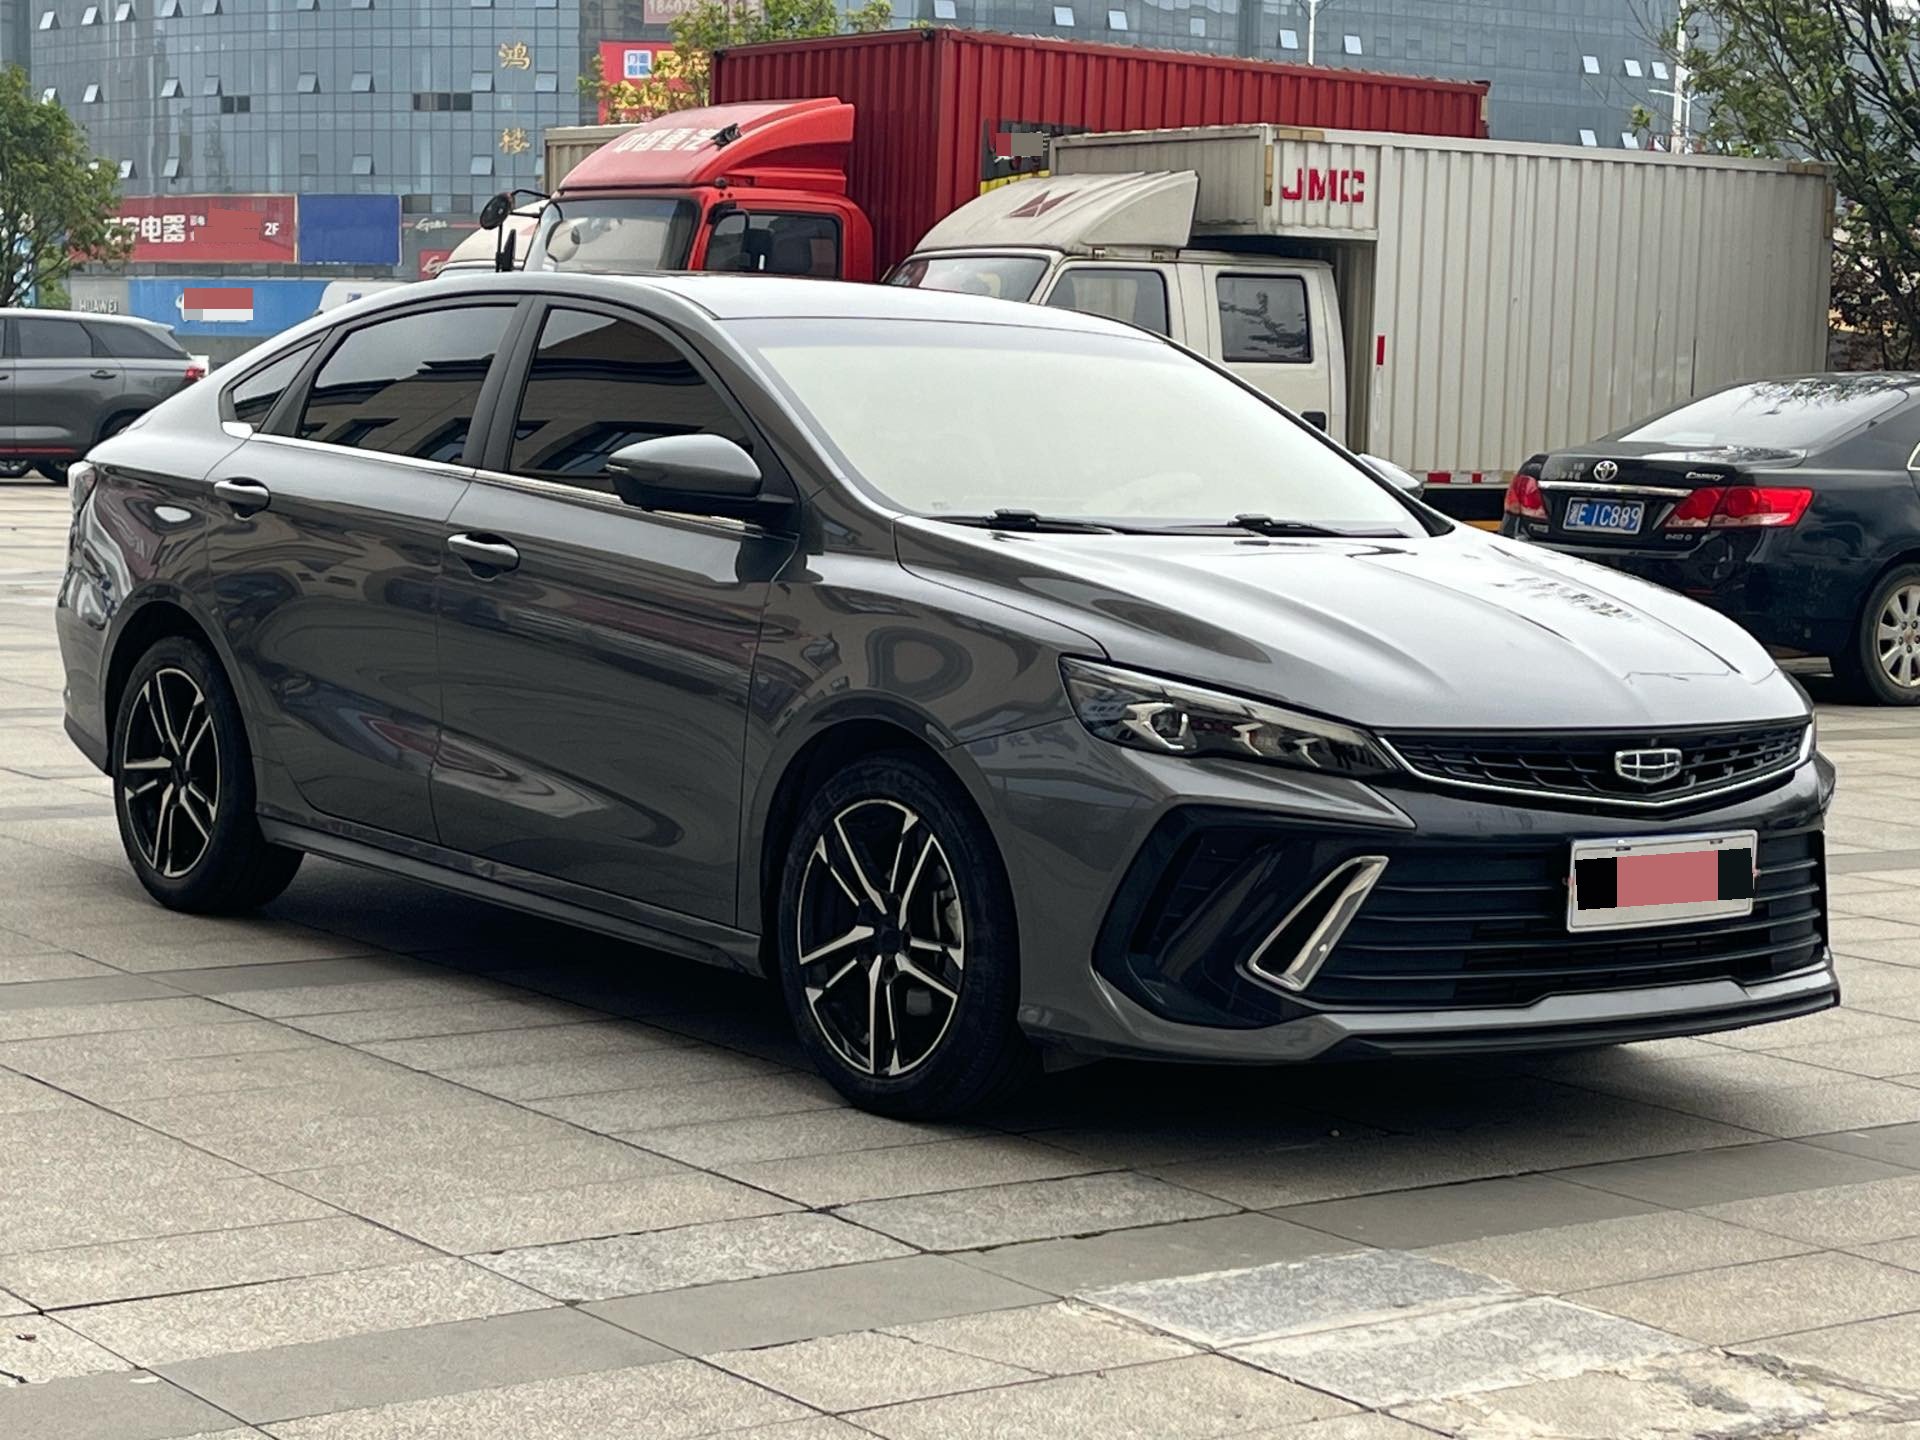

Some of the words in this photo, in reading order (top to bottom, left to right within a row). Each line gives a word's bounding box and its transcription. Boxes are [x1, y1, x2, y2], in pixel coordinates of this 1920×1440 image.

[1282, 168, 1365, 203] JMC
[264, 222, 280, 236] 2F
[79, 298, 119, 314] HUAWEI
